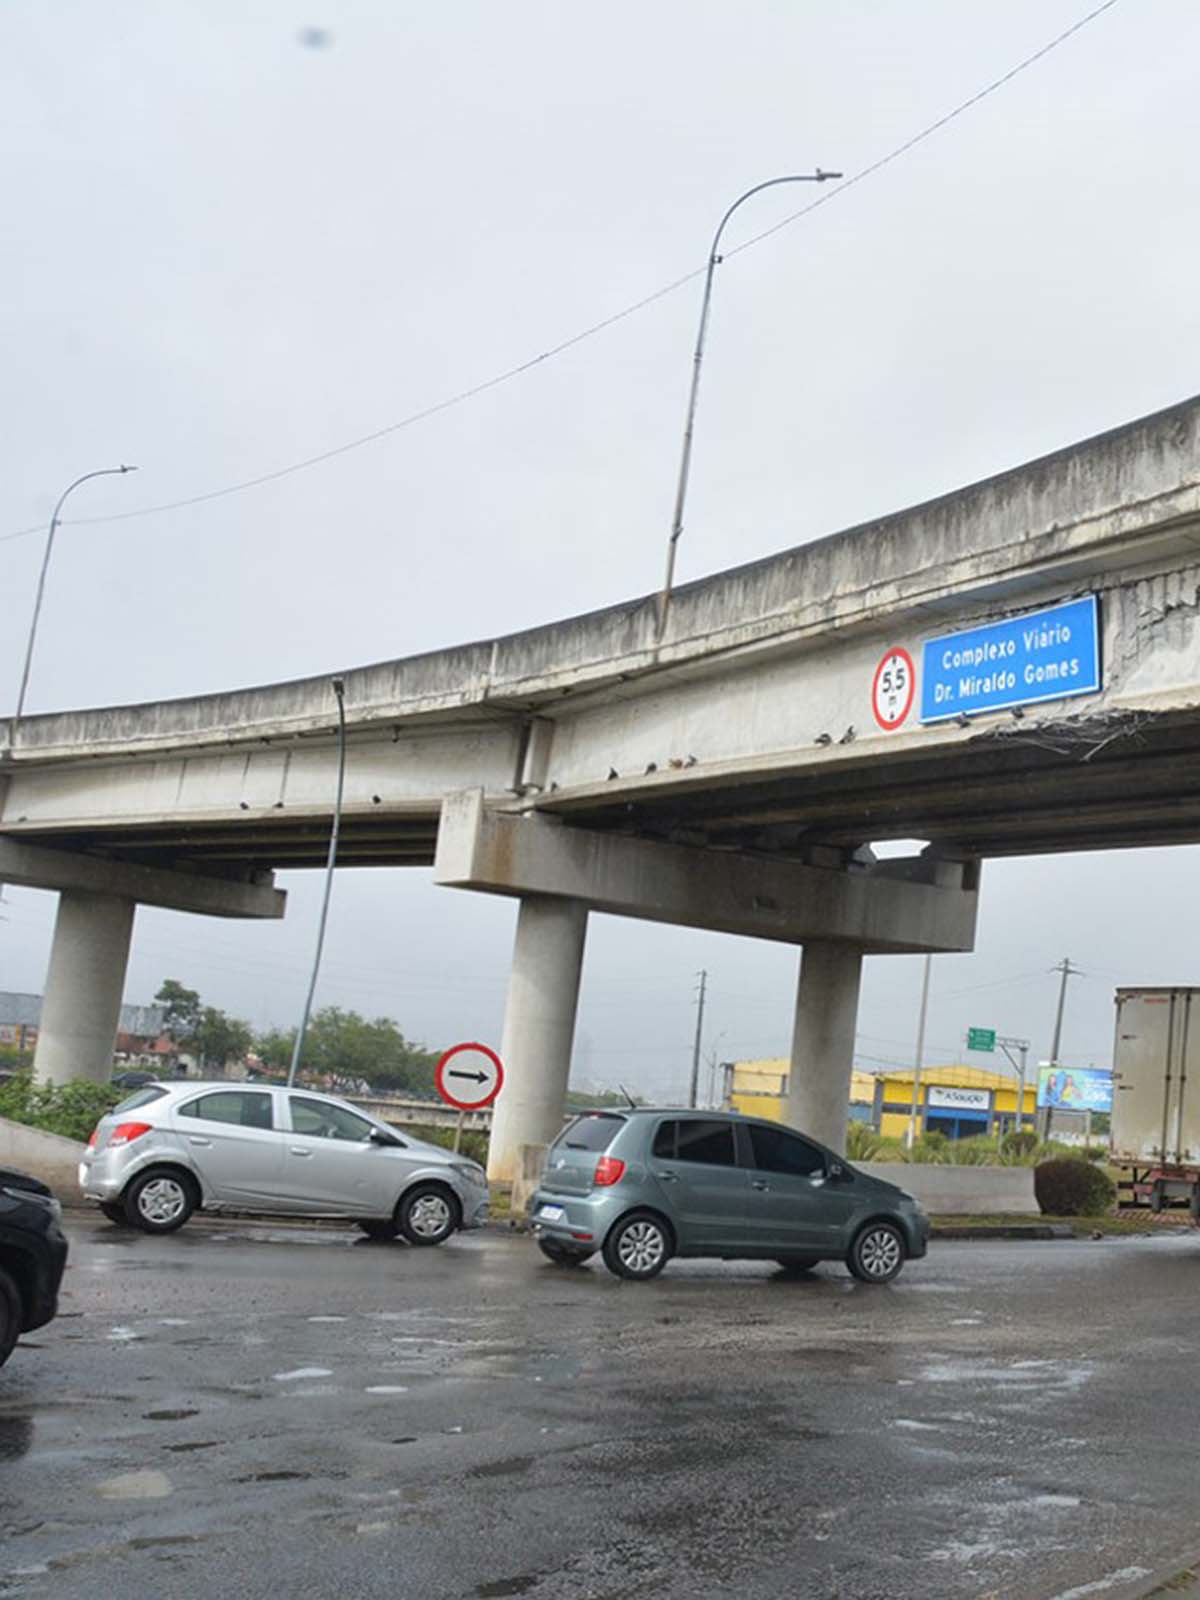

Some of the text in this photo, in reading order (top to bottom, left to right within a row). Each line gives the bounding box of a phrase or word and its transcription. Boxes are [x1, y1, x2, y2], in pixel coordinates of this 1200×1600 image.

[942, 621, 1072, 669] Complexo Viário
[934, 657, 1080, 703] Dr. Miraldo Gomes
